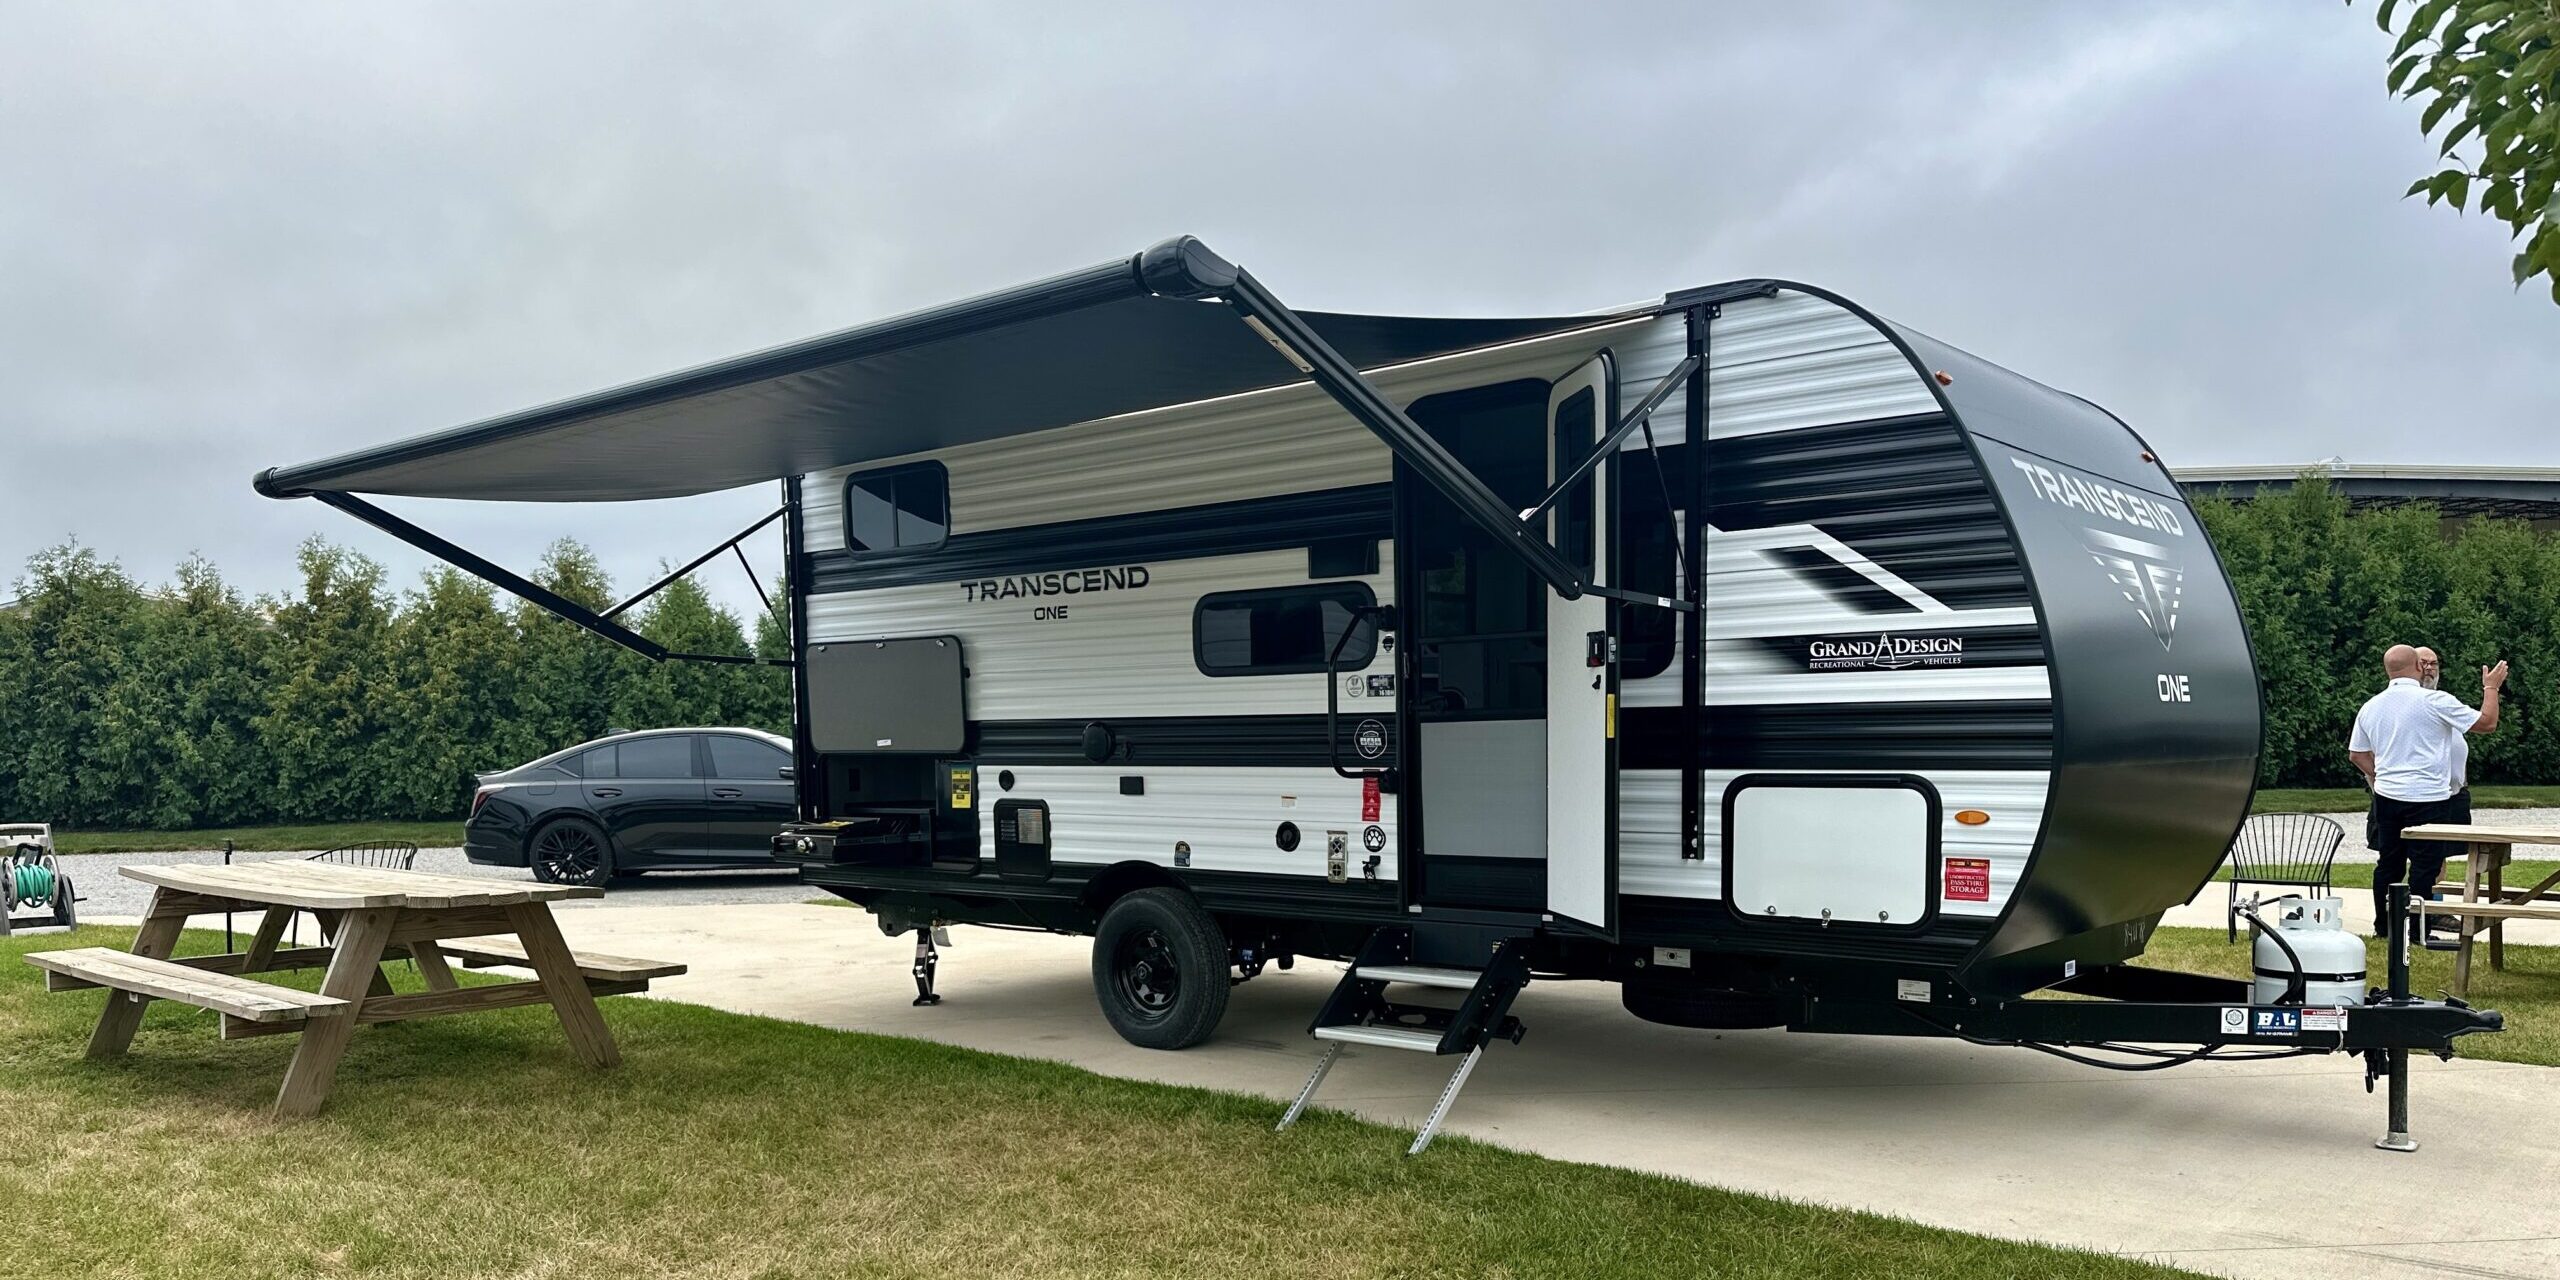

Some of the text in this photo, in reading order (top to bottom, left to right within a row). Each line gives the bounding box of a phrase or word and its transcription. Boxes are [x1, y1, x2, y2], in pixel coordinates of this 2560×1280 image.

[2011, 456, 2184, 537] TRANSCEND
[960, 566, 1149, 602] TRANSCEND
[1034, 605, 1068, 620] ONE
[1810, 638, 1962, 657] GRAND DESIGN
[1809, 657, 1962, 669] RECREATIONAL VEHICLES
[2157, 674, 2191, 702] ONE
[2257, 1012, 2297, 1026] BAL
